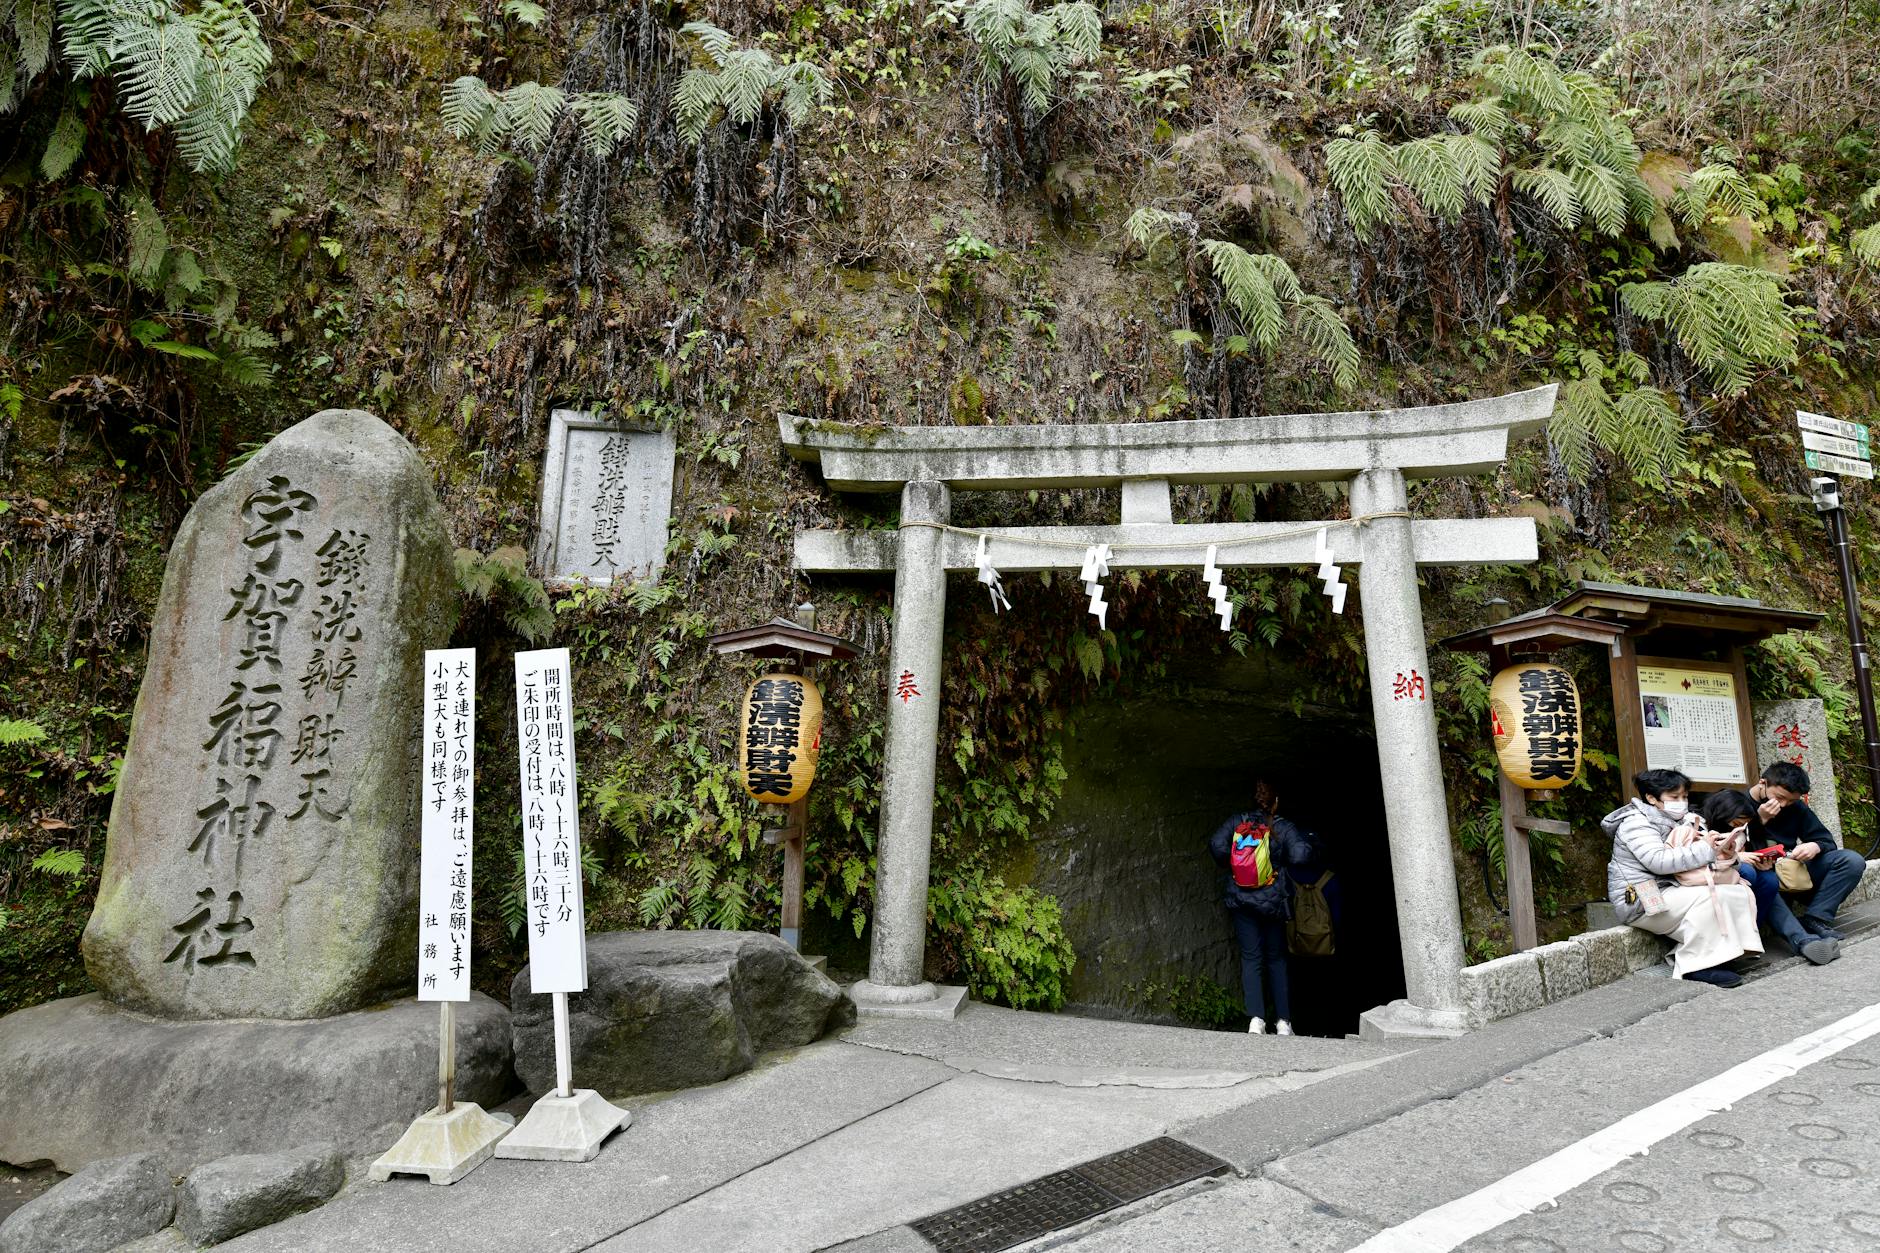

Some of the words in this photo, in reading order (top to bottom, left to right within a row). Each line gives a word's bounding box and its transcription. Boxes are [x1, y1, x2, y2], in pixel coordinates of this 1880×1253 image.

[163, 475, 318, 974] 宇賀福神社
[431, 661, 449, 814] 小型犬も同様です
[895, 669, 922, 704] 奉
[1393, 669, 1425, 701] 納
[449, 660, 471, 981] 犬を連れての御参拝は、ご遠慮願います
[423, 913, 439, 989] 社務所
